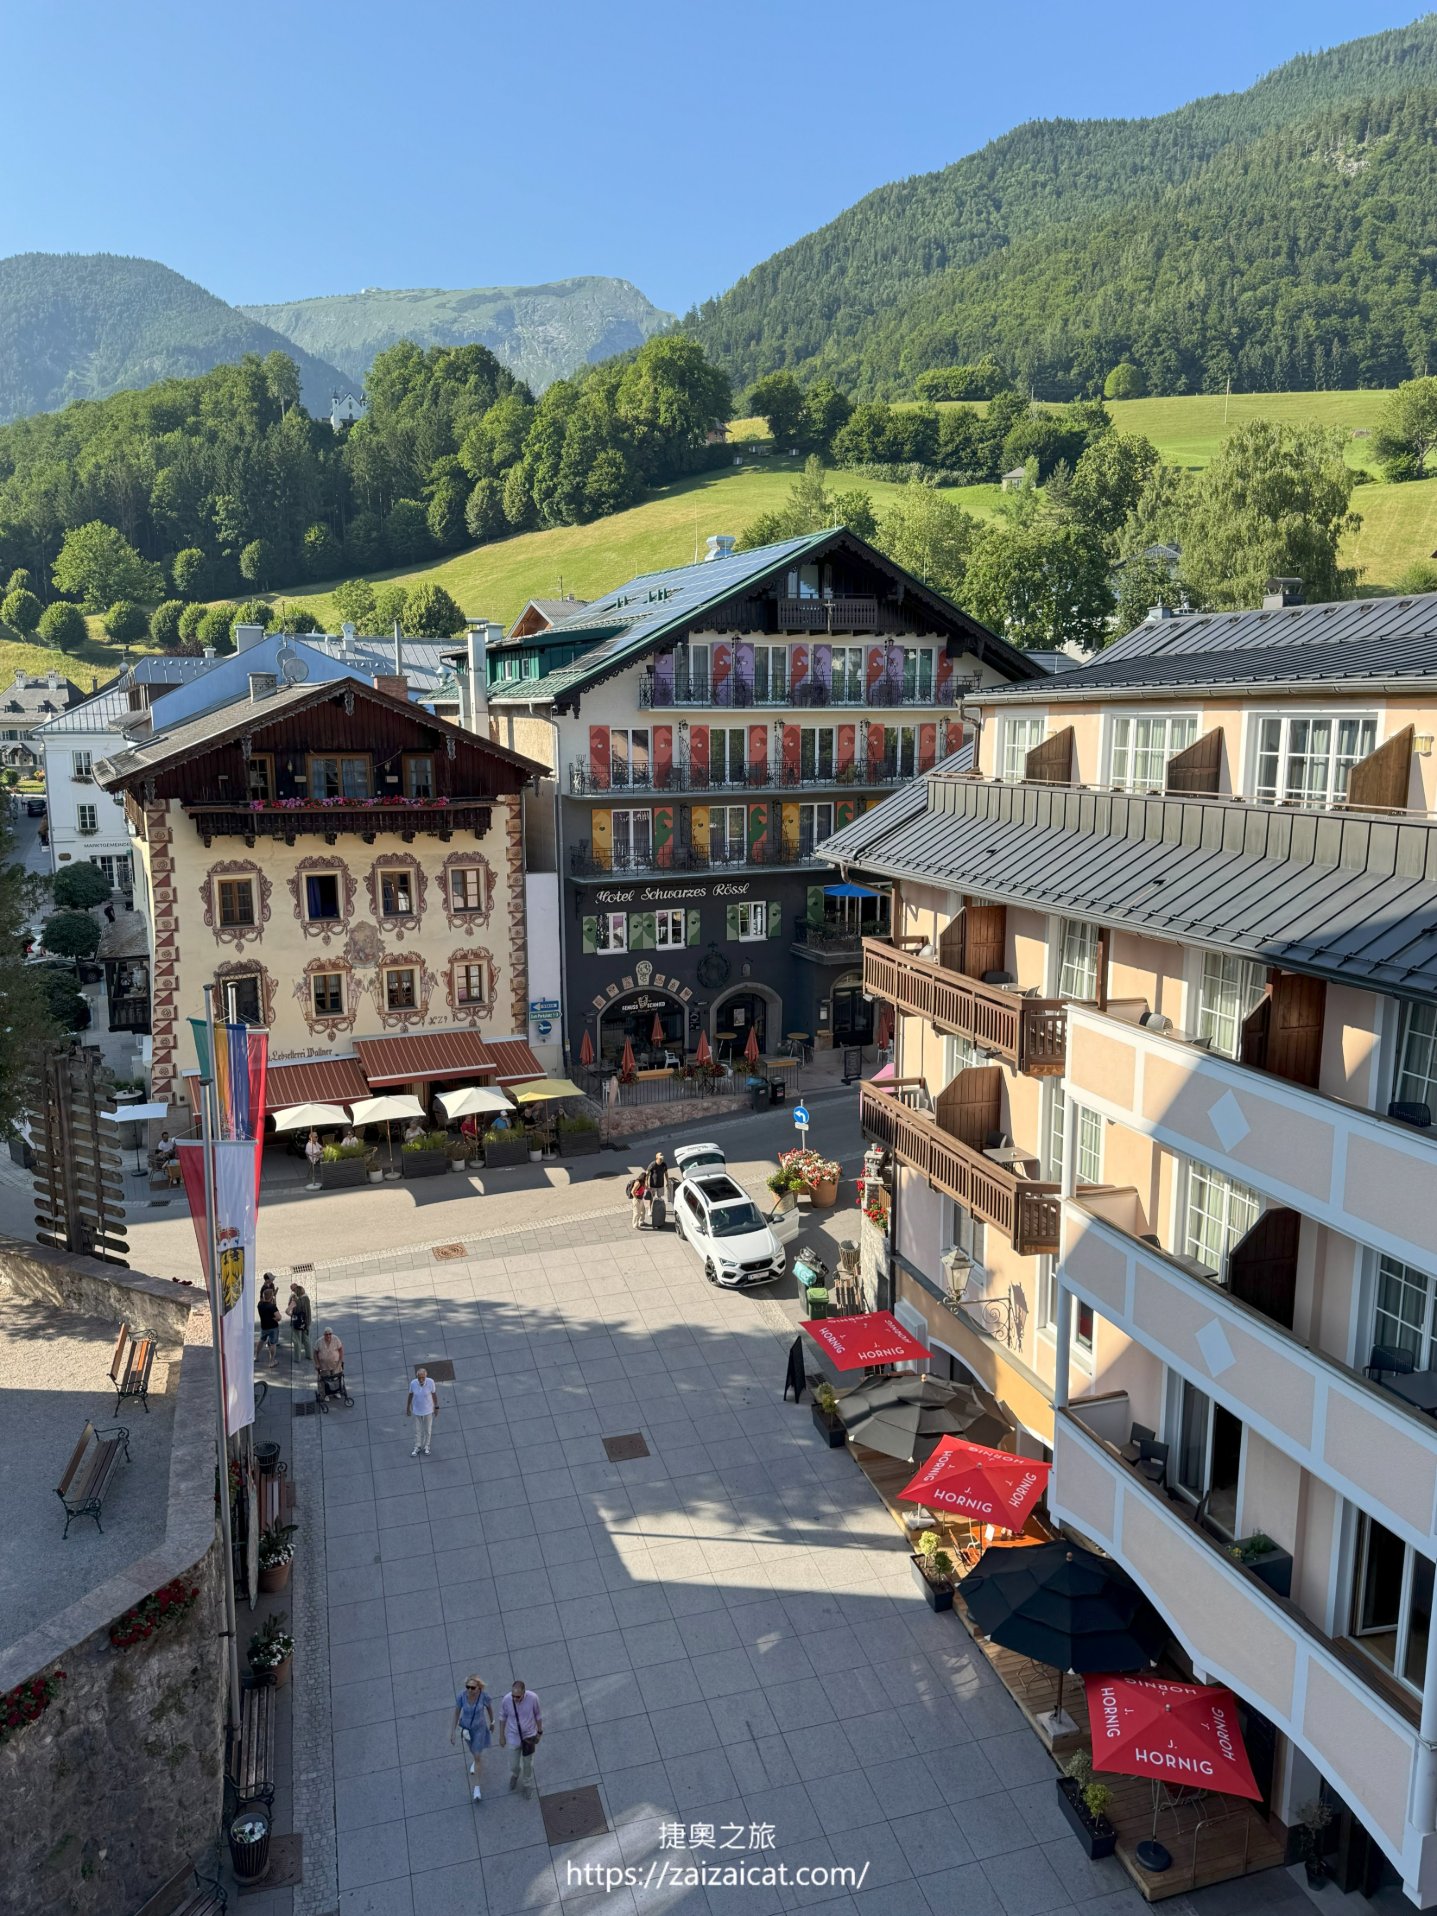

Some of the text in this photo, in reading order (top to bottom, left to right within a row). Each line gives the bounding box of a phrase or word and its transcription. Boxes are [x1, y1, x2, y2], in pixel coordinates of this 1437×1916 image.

[595, 882, 750, 904] Hotel Schwarzes Rössl
[819, 1327, 846, 1354] HORNIG
[857, 1346, 905, 1360] HORNIG
[923, 1450, 952, 1482] HORNIG
[933, 1488, 993, 1513] HORNIG
[964, 1486, 973, 1495] J.
[1008, 1472, 1037, 1508] HORNIG
[1124, 1677, 1197, 1695] HORNIG
[1101, 1687, 1121, 1738] HORNIG
[1167, 1739, 1178, 1749] J.
[1211, 1707, 1236, 1762] HORNIG
[1135, 1748, 1214, 1775] HORNIG
